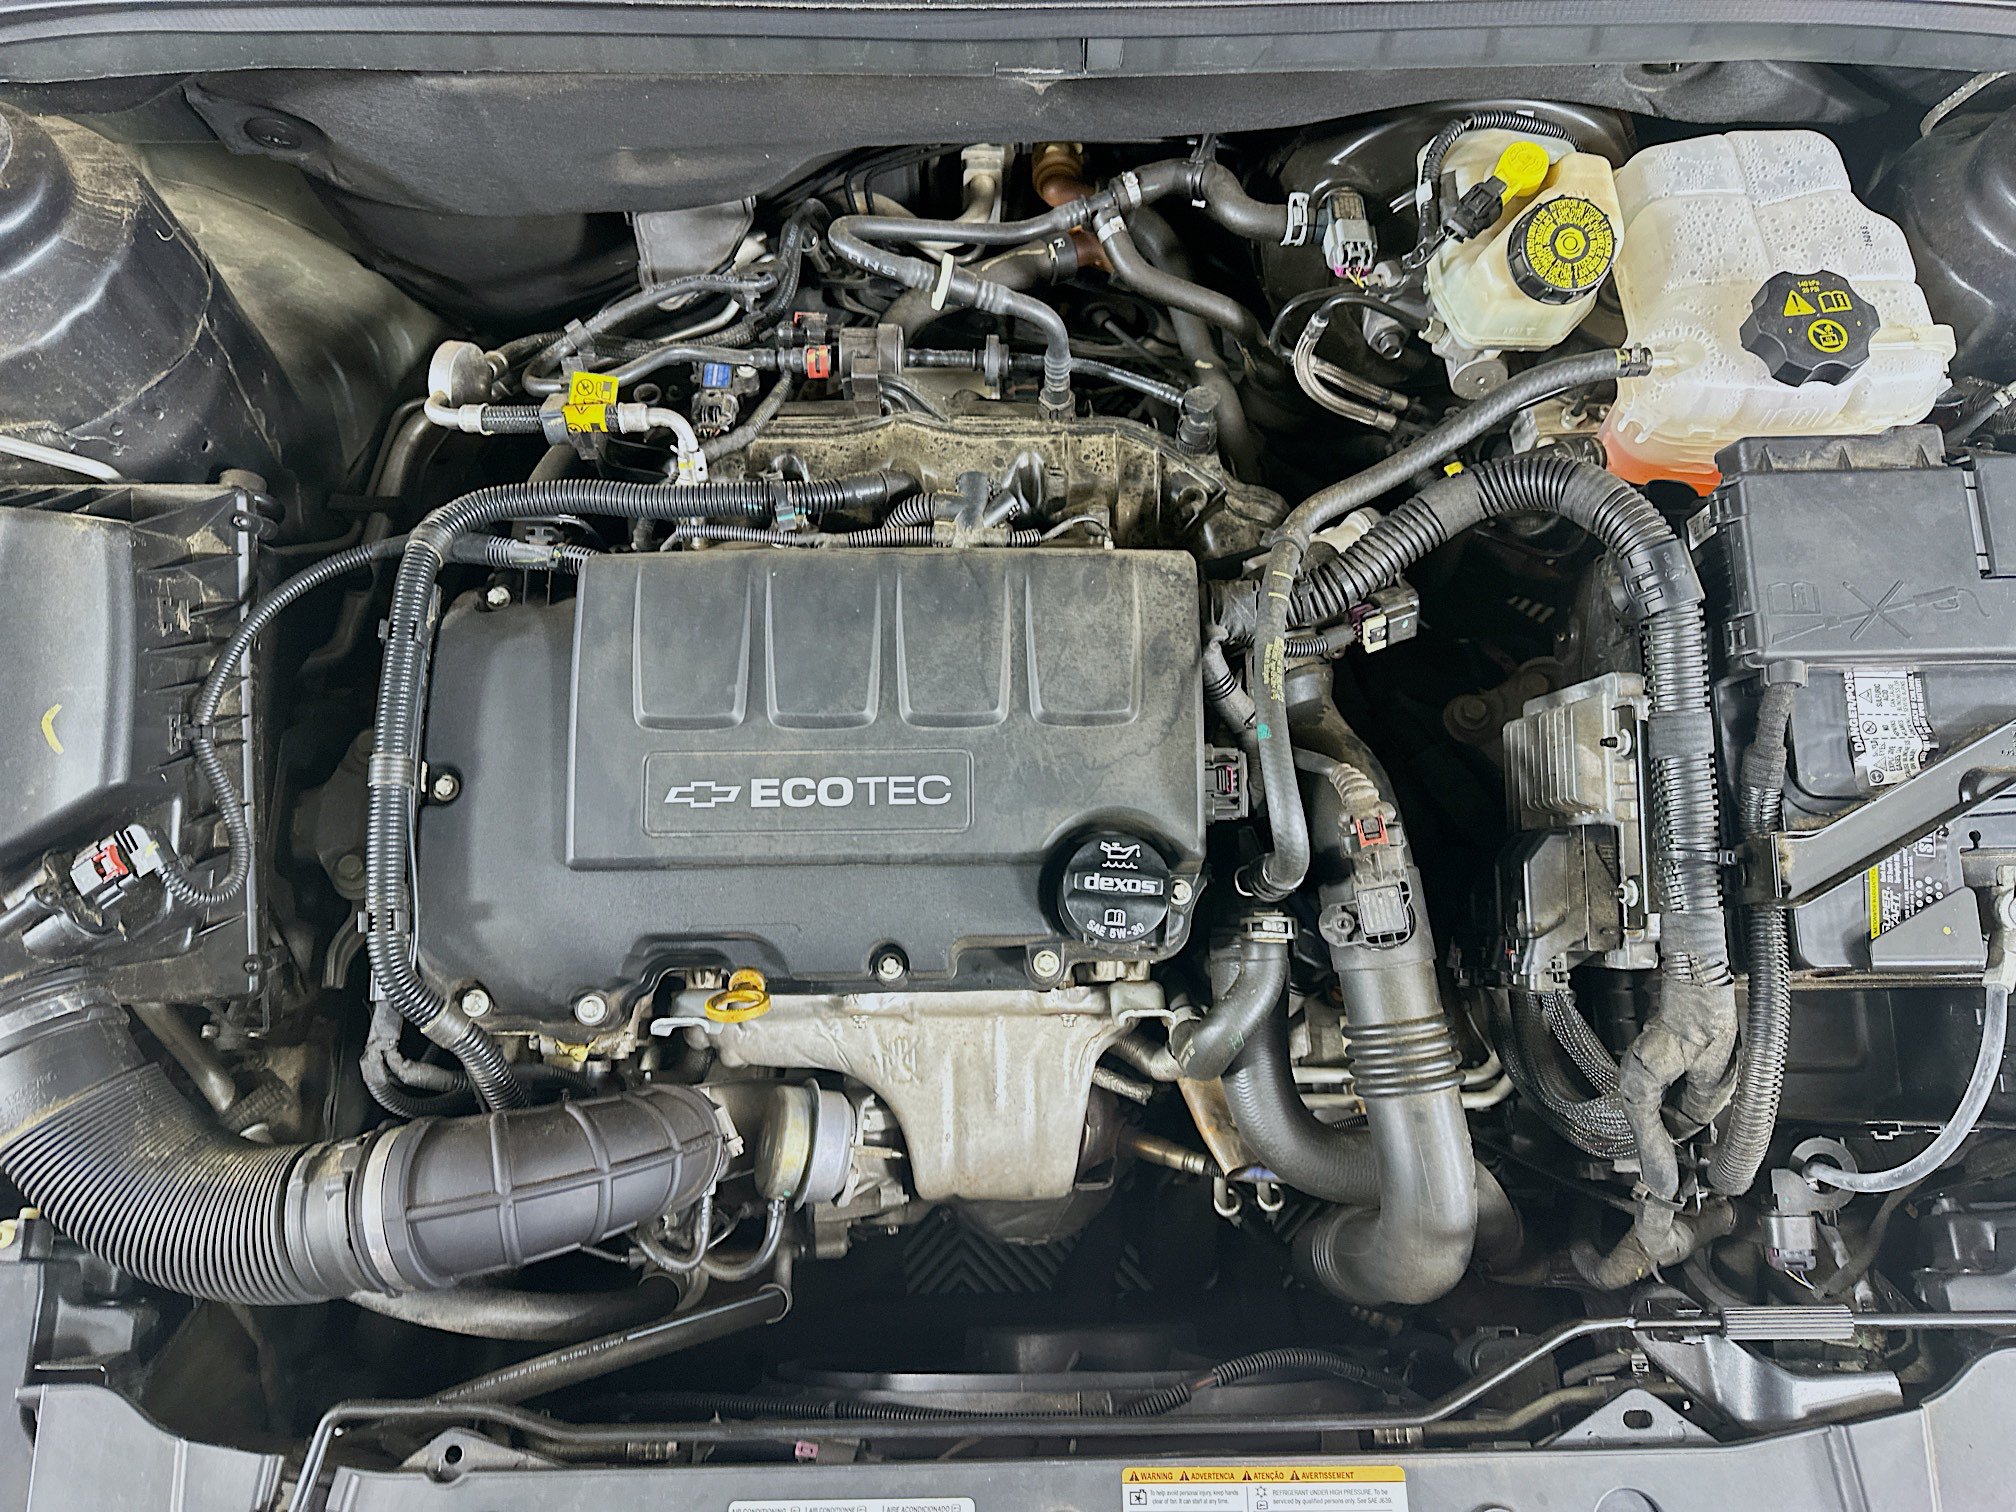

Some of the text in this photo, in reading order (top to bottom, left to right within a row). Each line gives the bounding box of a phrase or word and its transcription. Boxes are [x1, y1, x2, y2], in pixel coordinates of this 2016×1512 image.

[1844, 672, 1865, 751] DANGER/POIS
[750, 774, 952, 808] ECOTEC
[1084, 872, 1159, 894] dexos
[1086, 919, 1145, 939] SAE 5W-30
[1141, 1472, 1173, 1480] WARNING
[1191, 1472, 1234, 1480] ADVERTENCIA
[1254, 1471, 1284, 1480] ATENÇÃO
